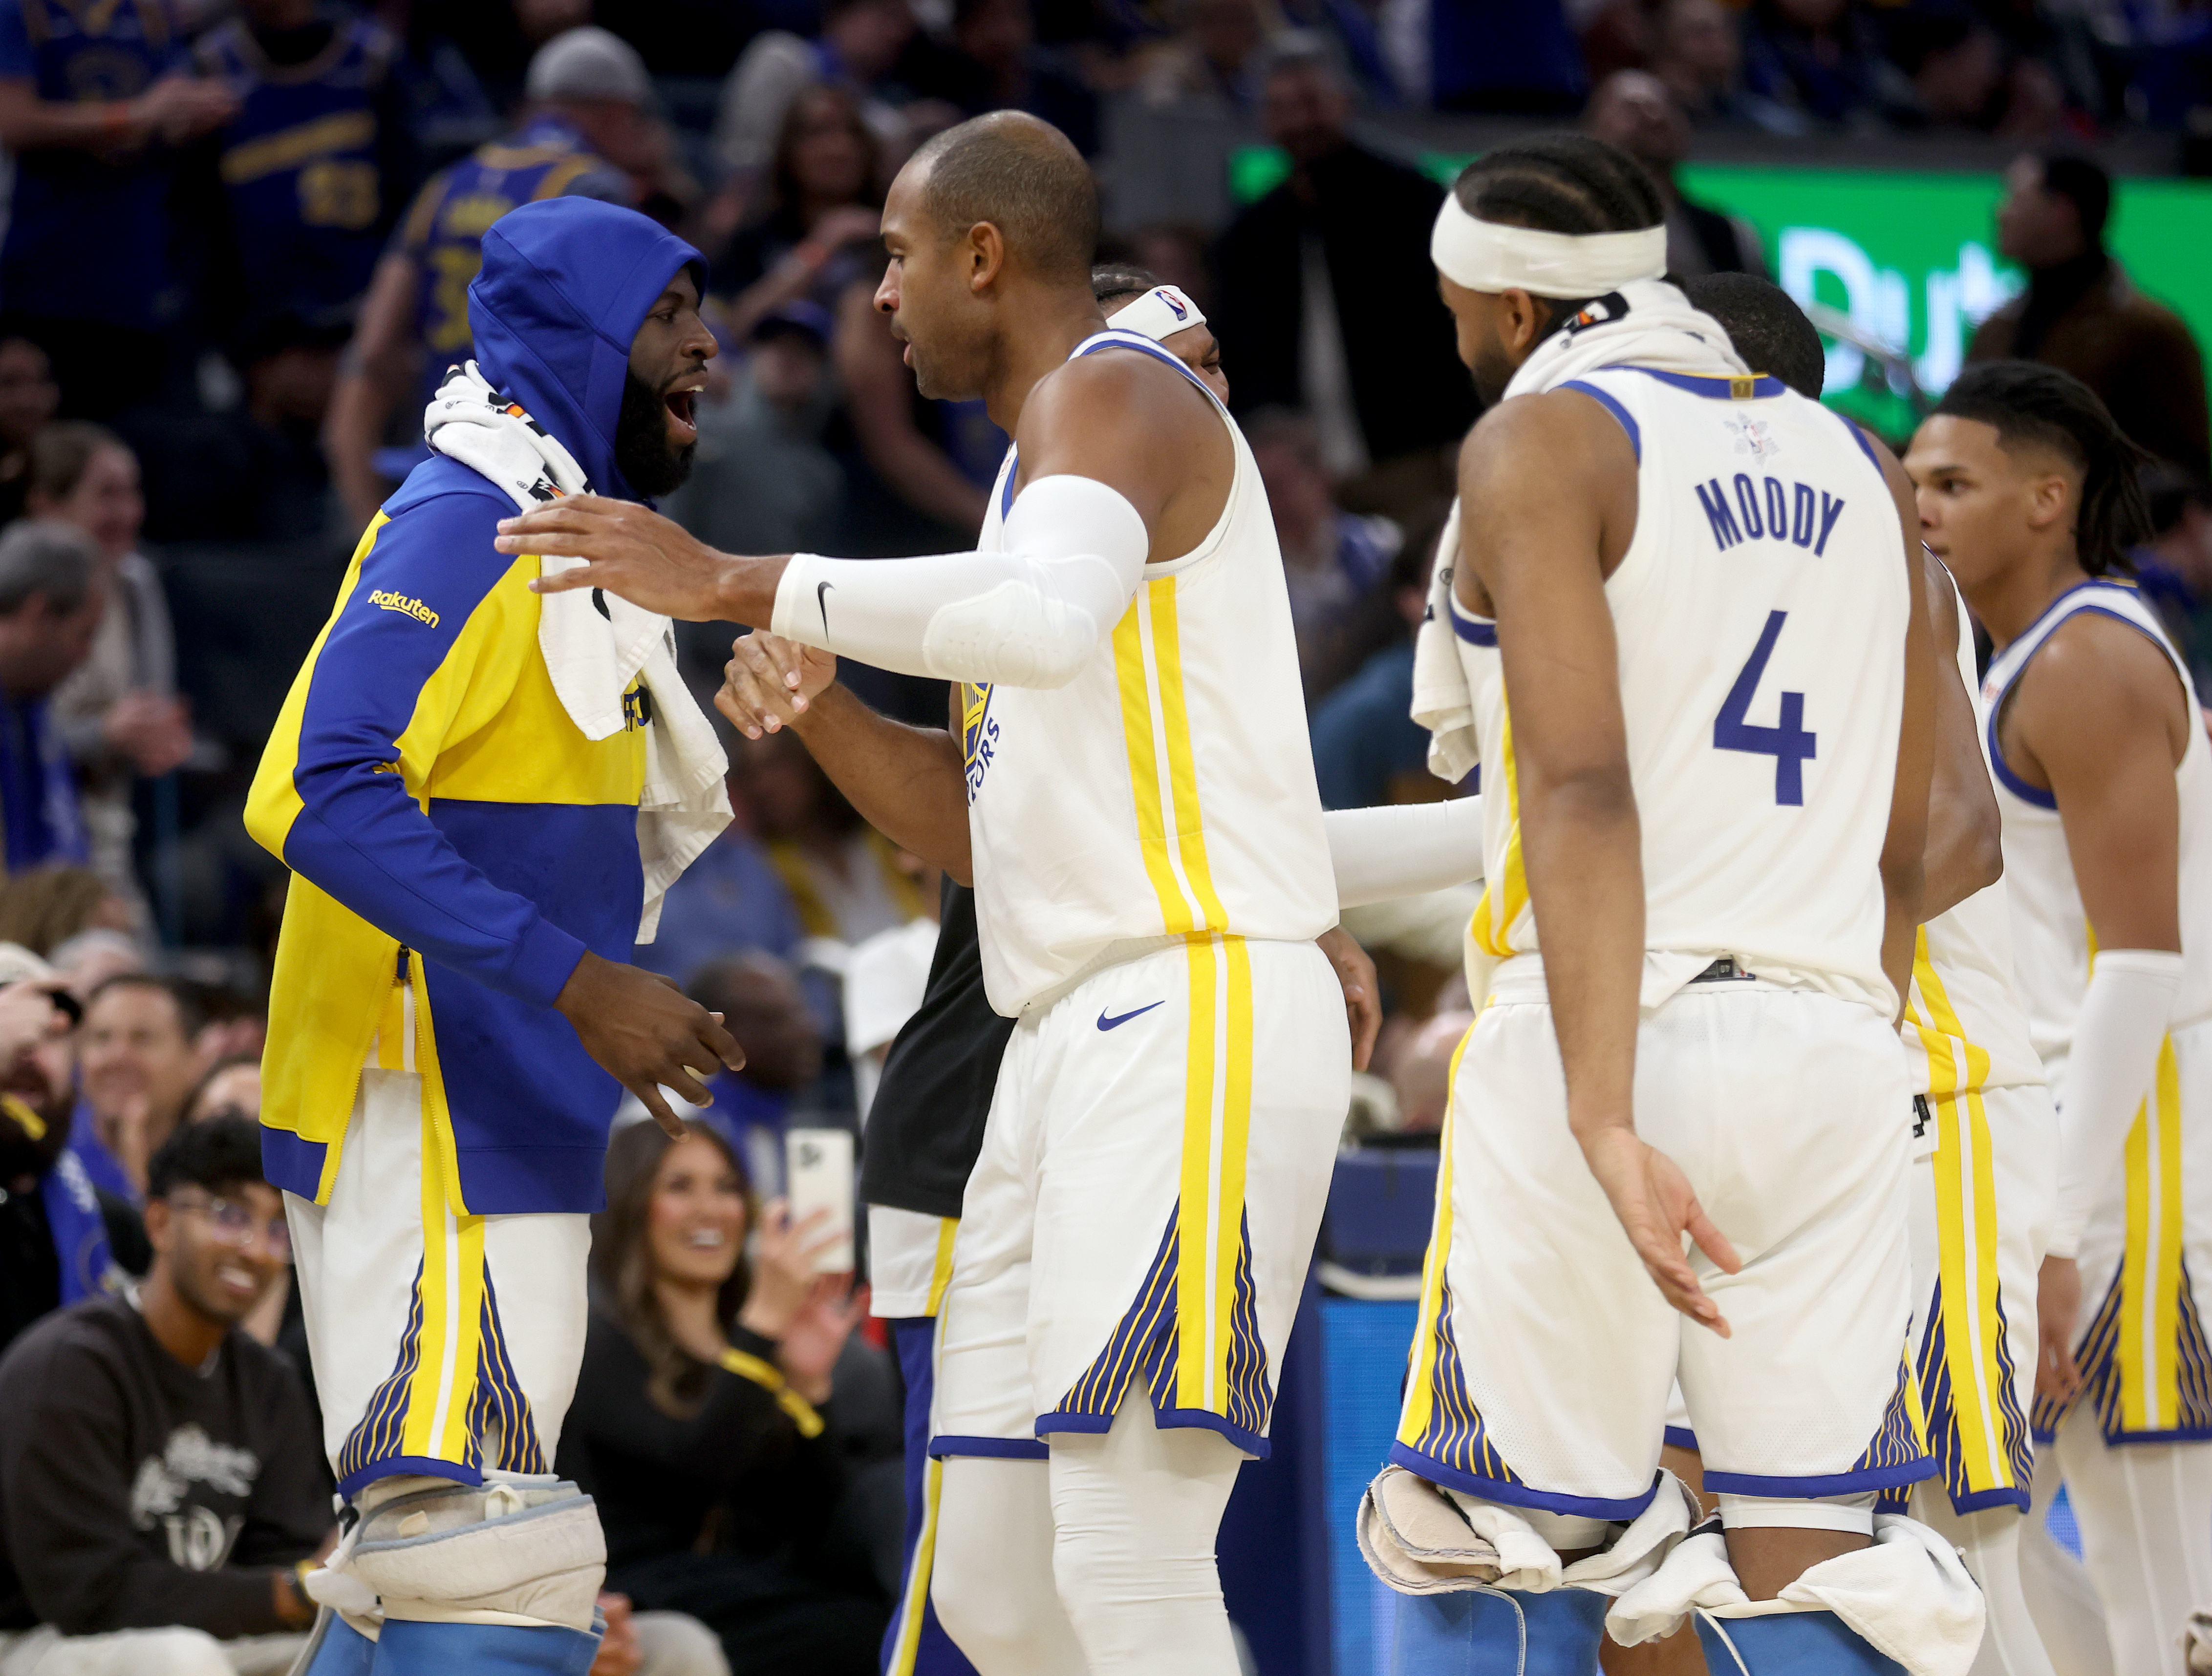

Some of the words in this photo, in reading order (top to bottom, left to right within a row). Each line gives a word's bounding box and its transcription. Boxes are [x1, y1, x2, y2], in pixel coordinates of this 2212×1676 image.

[1695, 473, 1845, 558] MOODY
[367, 589, 440, 629] Rakuten
[1713, 609, 1817, 806] 4
